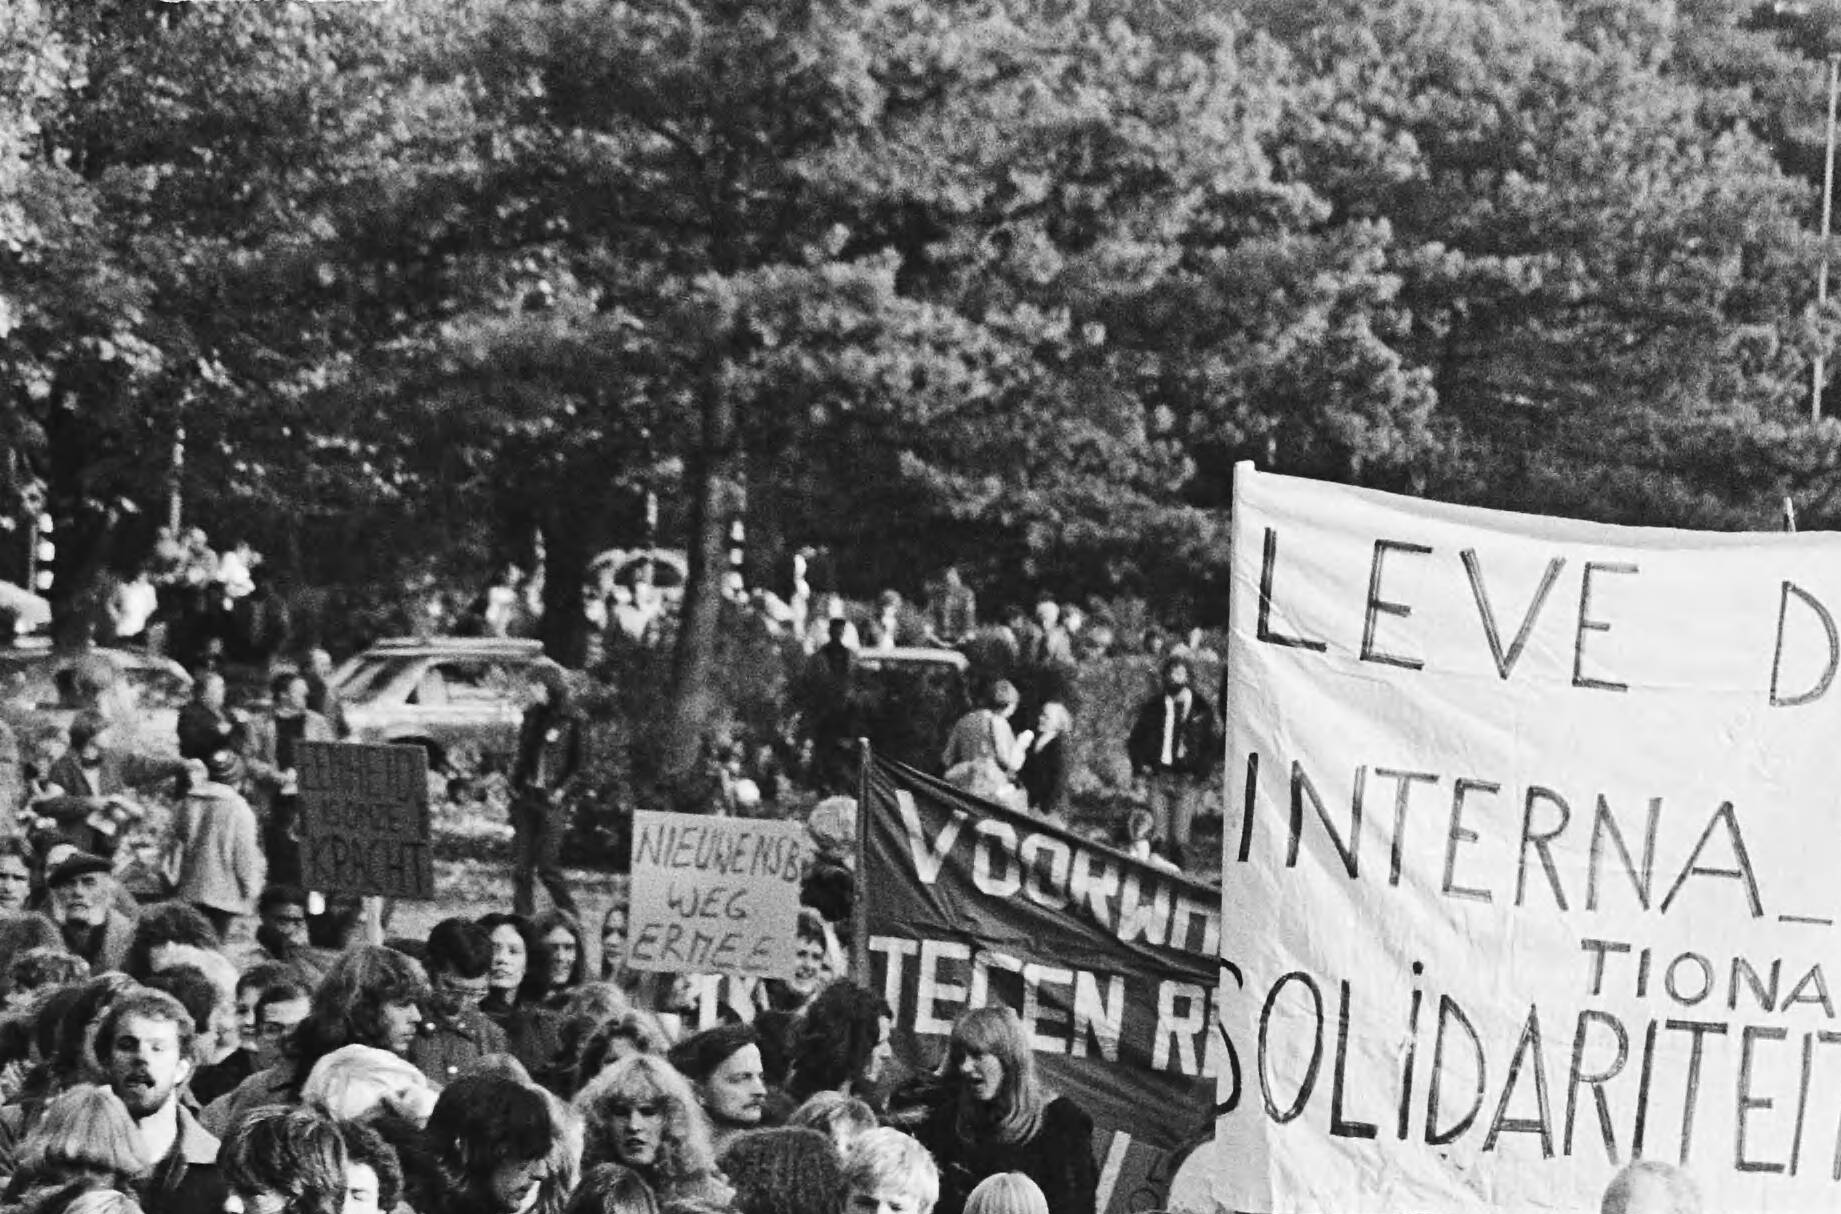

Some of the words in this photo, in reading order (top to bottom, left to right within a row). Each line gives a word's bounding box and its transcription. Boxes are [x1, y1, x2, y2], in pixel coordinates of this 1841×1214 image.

[1256, 526, 1640, 692] LEVE
[667, 880, 749, 919] WEG
[632, 922, 775, 970] ERMEE
